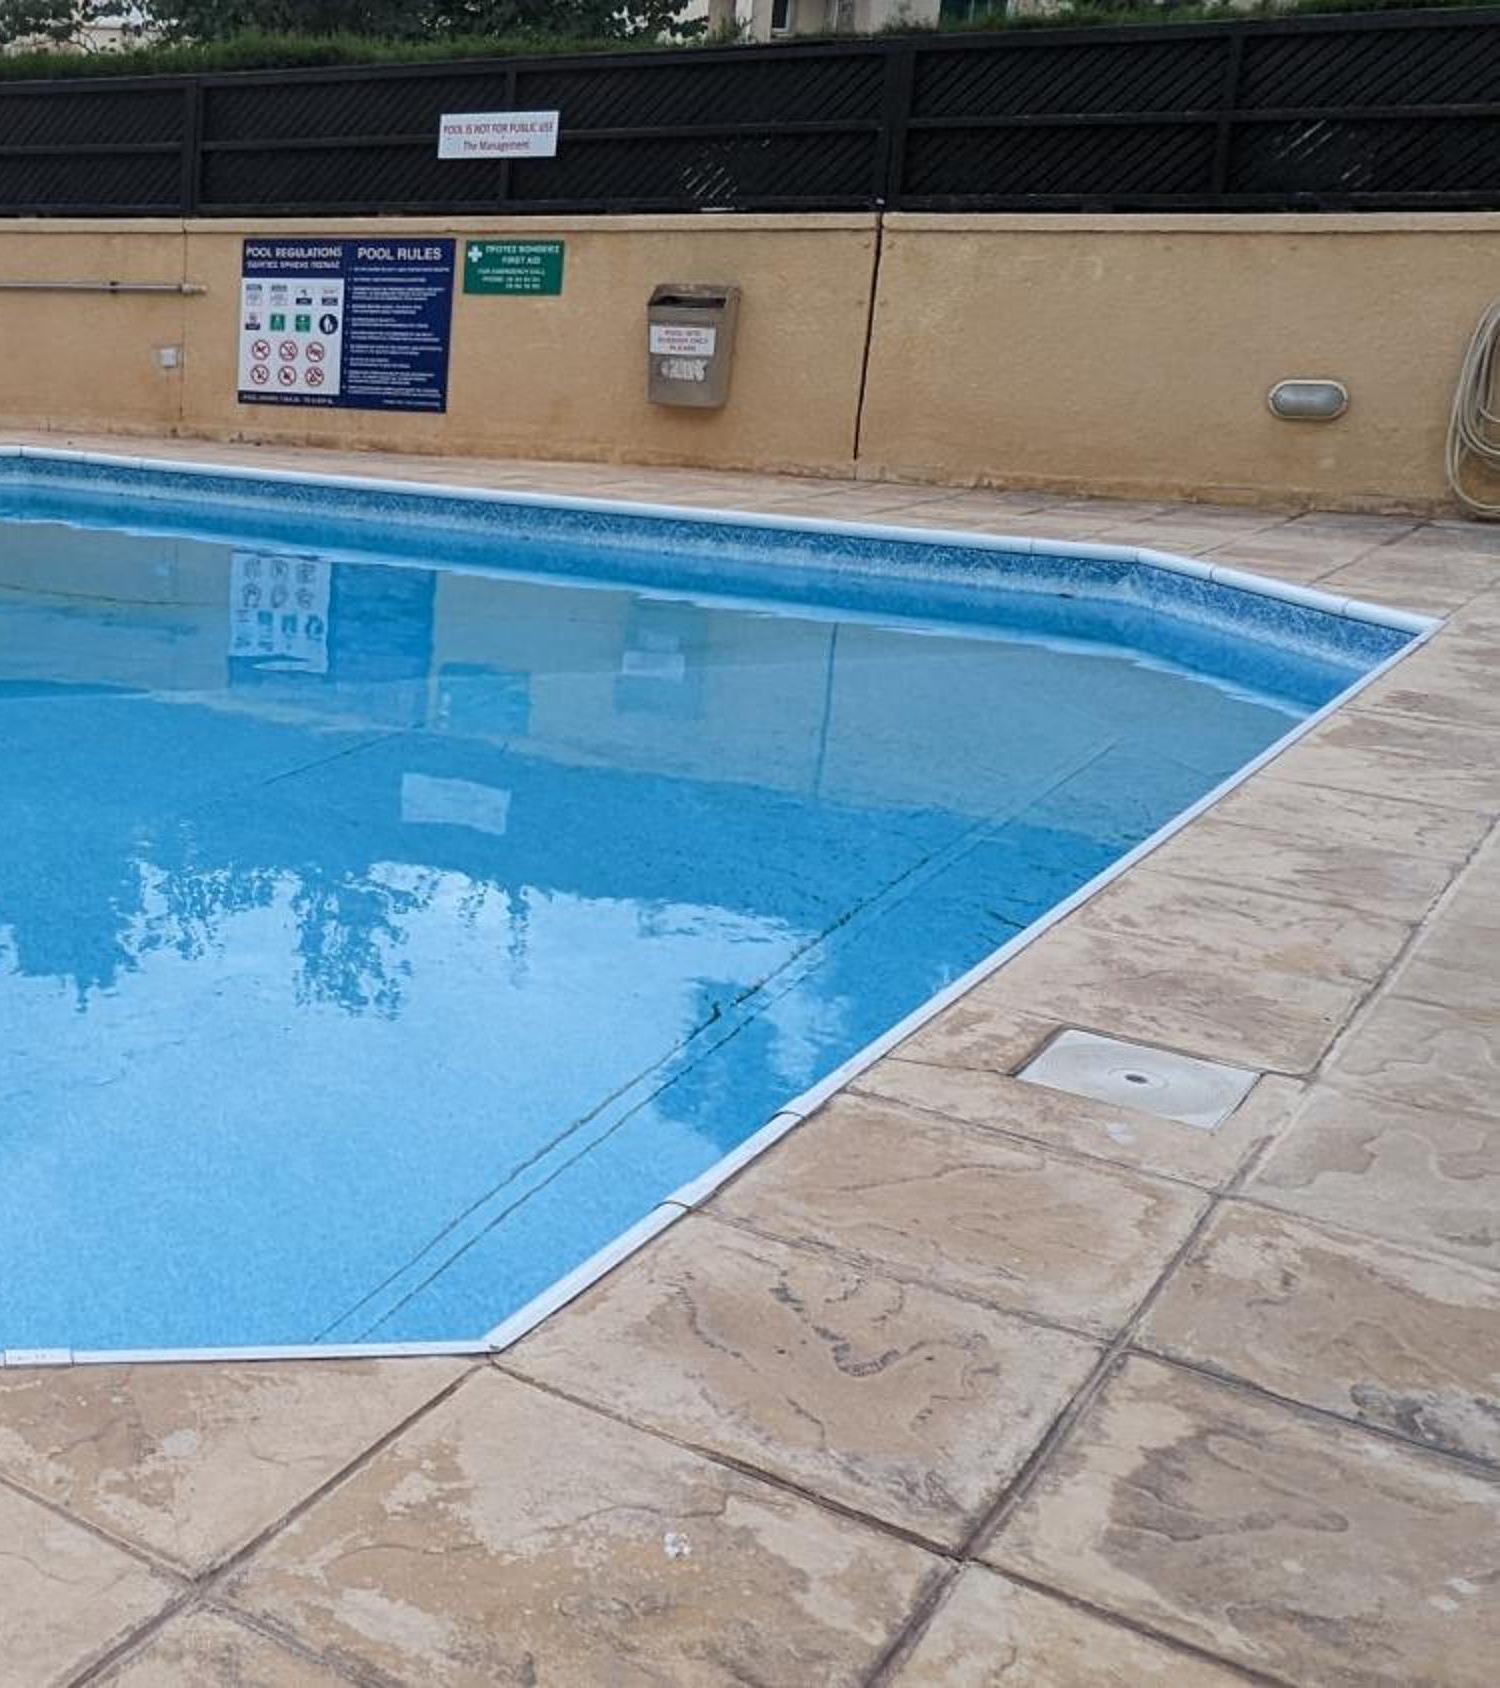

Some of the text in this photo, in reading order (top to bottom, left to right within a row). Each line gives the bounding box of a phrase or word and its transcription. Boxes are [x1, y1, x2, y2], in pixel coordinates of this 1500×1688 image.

[443, 125, 465, 135] POOL
[473, 124, 490, 134] NOT
[491, 123, 508, 133] FOR
[510, 123, 537, 133] PUBLIC
[463, 140, 531, 153] The Management
[246, 246, 342, 258] POOL REGULATIONS
[357, 247, 443, 261] POOL RULES
[502, 256, 541, 264] FIRST AID
